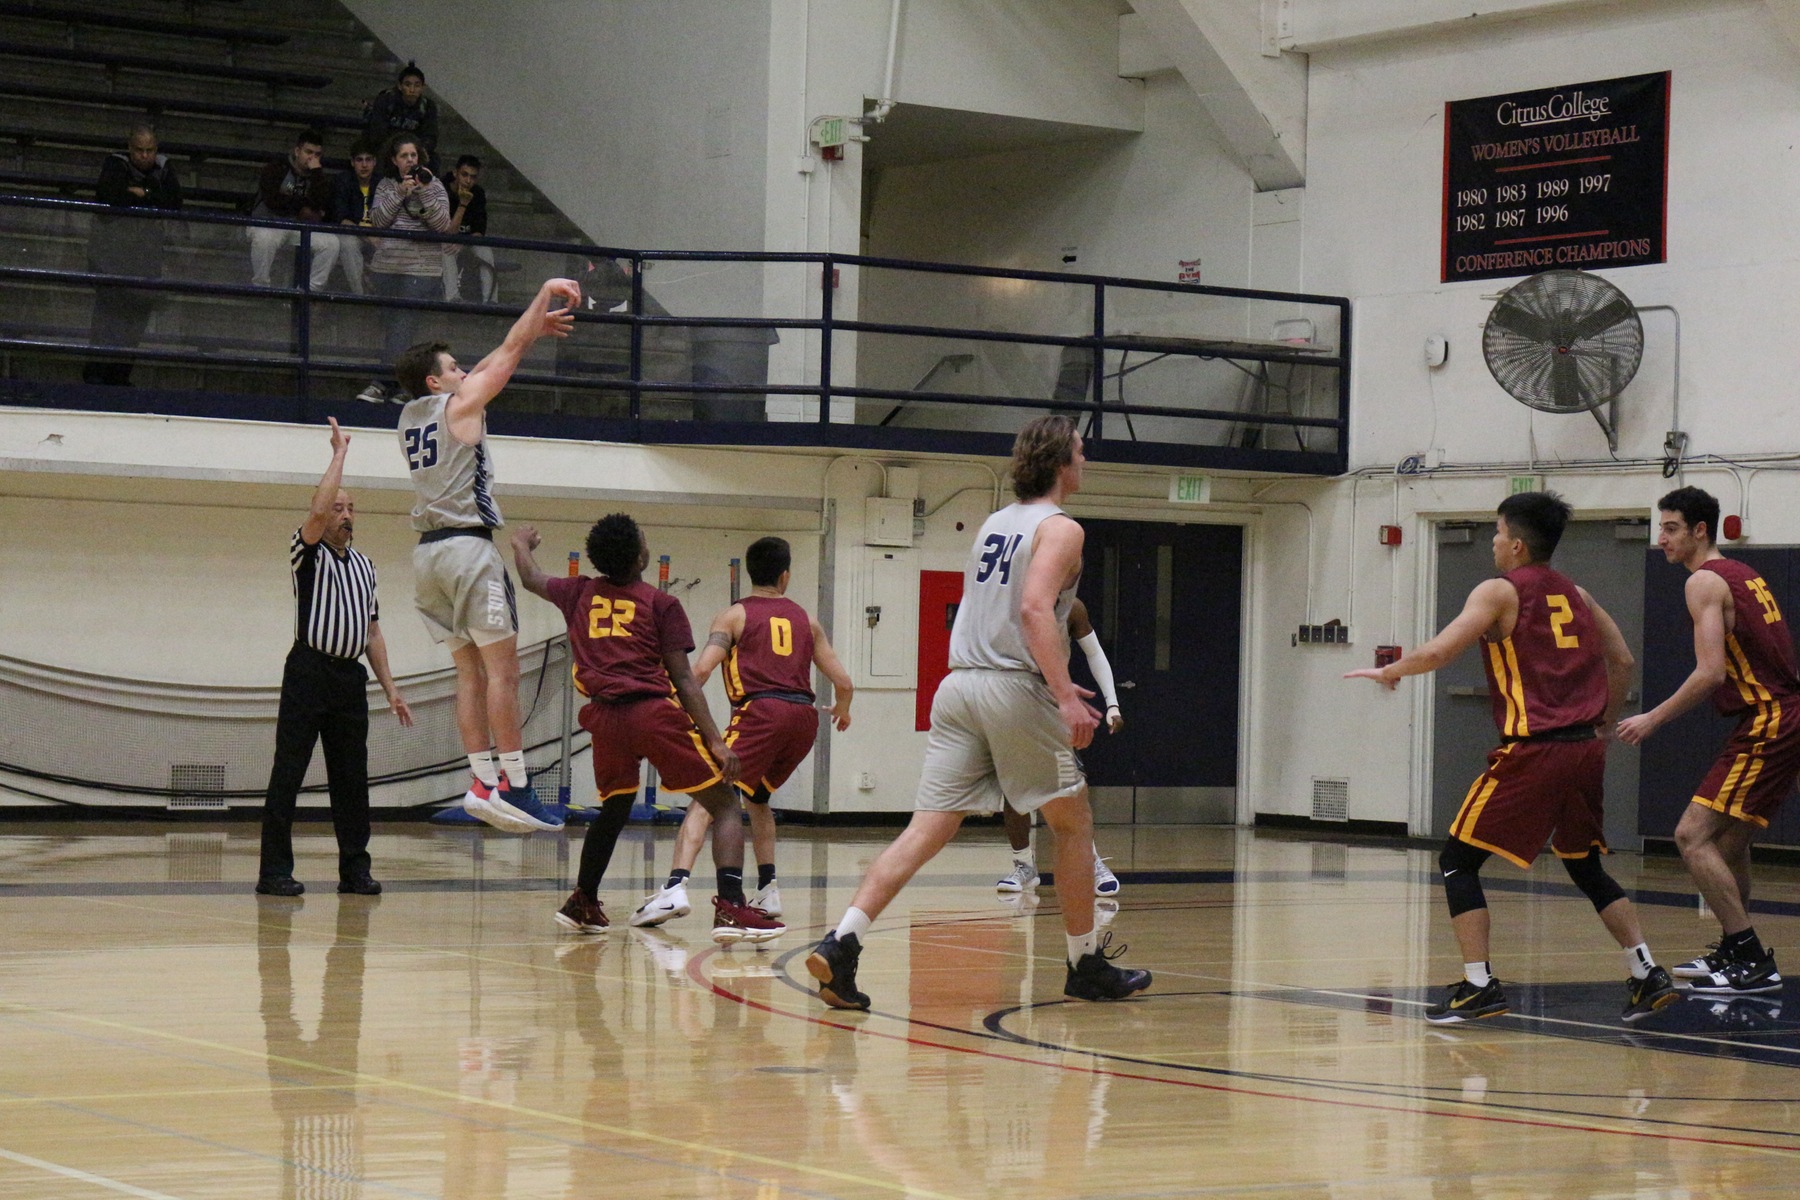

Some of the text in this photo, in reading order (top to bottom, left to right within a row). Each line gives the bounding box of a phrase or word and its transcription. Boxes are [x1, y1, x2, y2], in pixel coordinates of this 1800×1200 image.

[1497, 91, 1610, 126] Citrus College
[825, 119, 843, 144] EXIT
[1471, 125, 1641, 162] WOMEN'S VOLLEYBALL
[1456, 174, 1612, 208] 1980 1983 1989 1997
[1456, 204, 1569, 232] 1982 1987 1996
[1456, 238, 1651, 273] CONFERENCE CHAMPIONS
[404, 421, 438, 471] 25
[1177, 476, 1204, 501] EXIT
[976, 532, 1024, 586] 34
[589, 595, 636, 638] 22
[1744, 576, 1781, 625] 35
[770, 616, 793, 657] 0
[1546, 594, 1579, 649] 2
